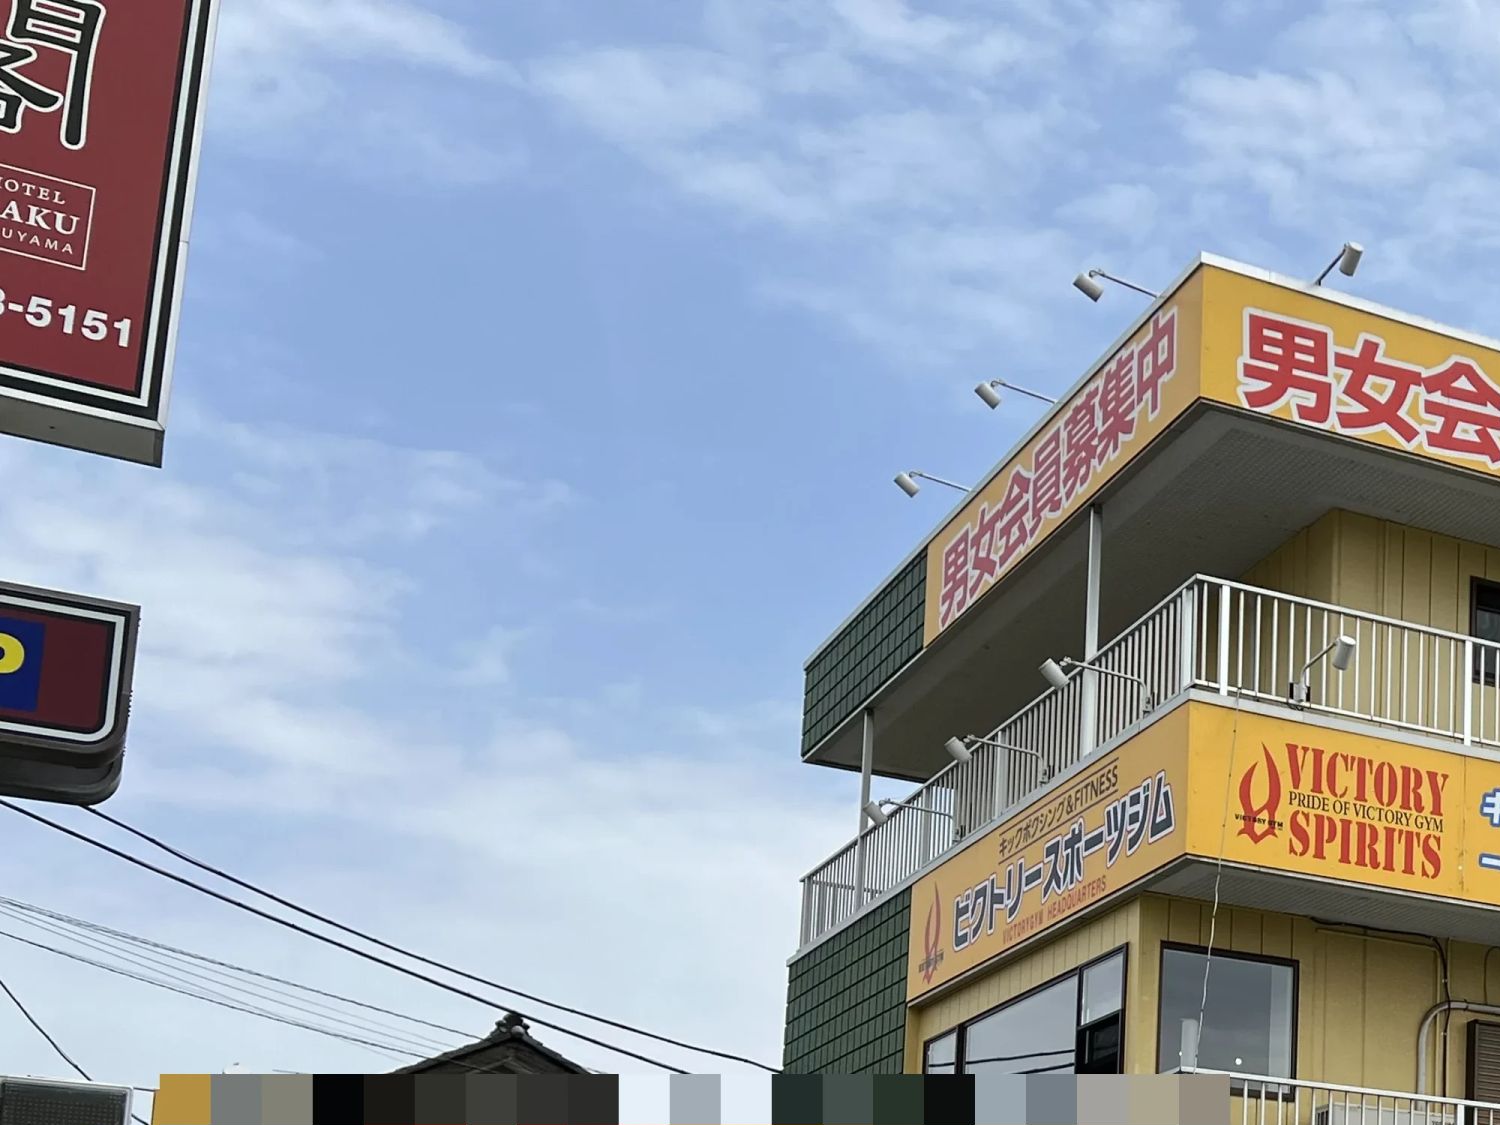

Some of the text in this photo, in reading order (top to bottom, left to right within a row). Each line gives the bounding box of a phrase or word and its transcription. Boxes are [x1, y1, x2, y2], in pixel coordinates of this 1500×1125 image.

[0, 176, 66, 205] OTEL
[0, 200, 80, 235] AKU
[1, 227, 74, 254] UYAMA
[0, 287, 131, 348] -5151
[939, 306, 1178, 631] 男女会員募集中
[1285, 743, 1449, 817] VICTORY
[1288, 790, 1444, 833] PRIDE OF VICTORY GYM
[953, 769, 1176, 953] ビクトリースポーツジム
[1288, 810, 1442, 880] SPIRITS
